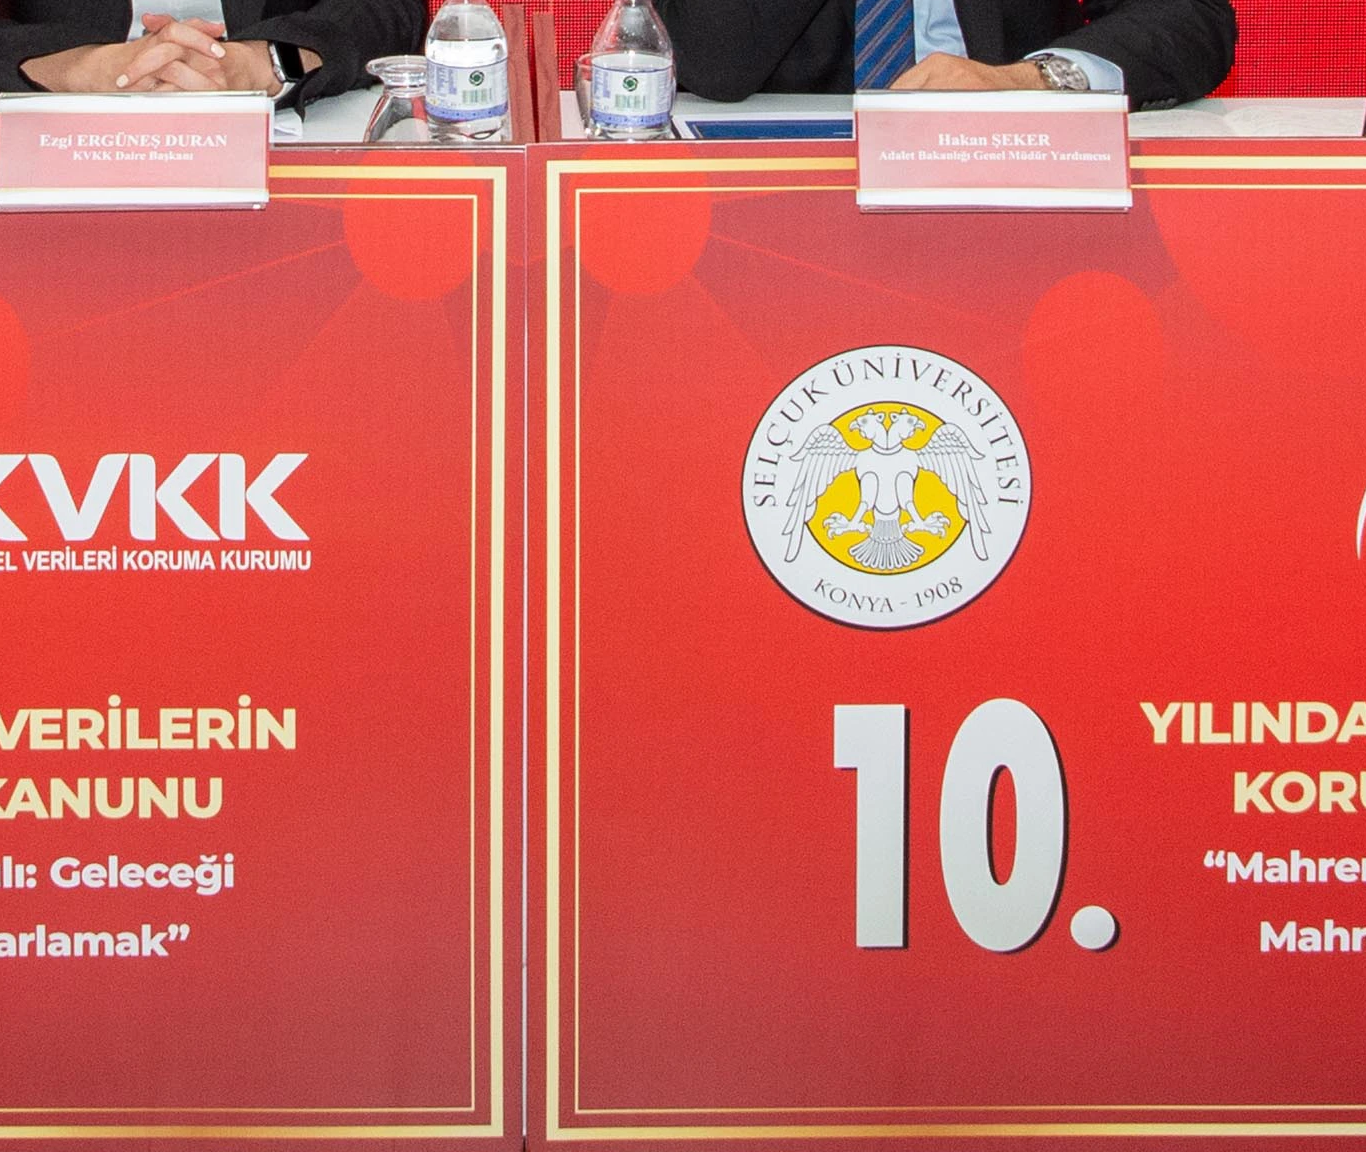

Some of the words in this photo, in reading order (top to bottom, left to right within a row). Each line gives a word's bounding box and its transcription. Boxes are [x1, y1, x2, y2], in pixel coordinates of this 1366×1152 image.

[39, 134, 72, 149] Ezgi
[77, 132, 160, 149] ERGÜNEŞ
[166, 135, 227, 147] DURAN
[938, 134, 986, 146] Hakan
[992, 134, 1050, 148] ŞEKER
[73, 151, 111, 161] KVKK
[116, 151, 146, 161] Daire
[879, 151, 914, 161] Adalet
[974, 151, 1005, 161] Genel
[753, 379, 829, 507] SELÇUK
[832, 352, 1024, 506] ÜNİVERSİTESİ
[23, 546, 116, 570] VERİLERİ
[123, 550, 215, 570] KORUMA
[221, 550, 311, 570] KURUMU
[814, 577, 894, 613] KONYA
[914, 576, 963, 608] 1908
[833, 697, 1120, 955] 10.
[50, 853, 233, 895] Geleceği
